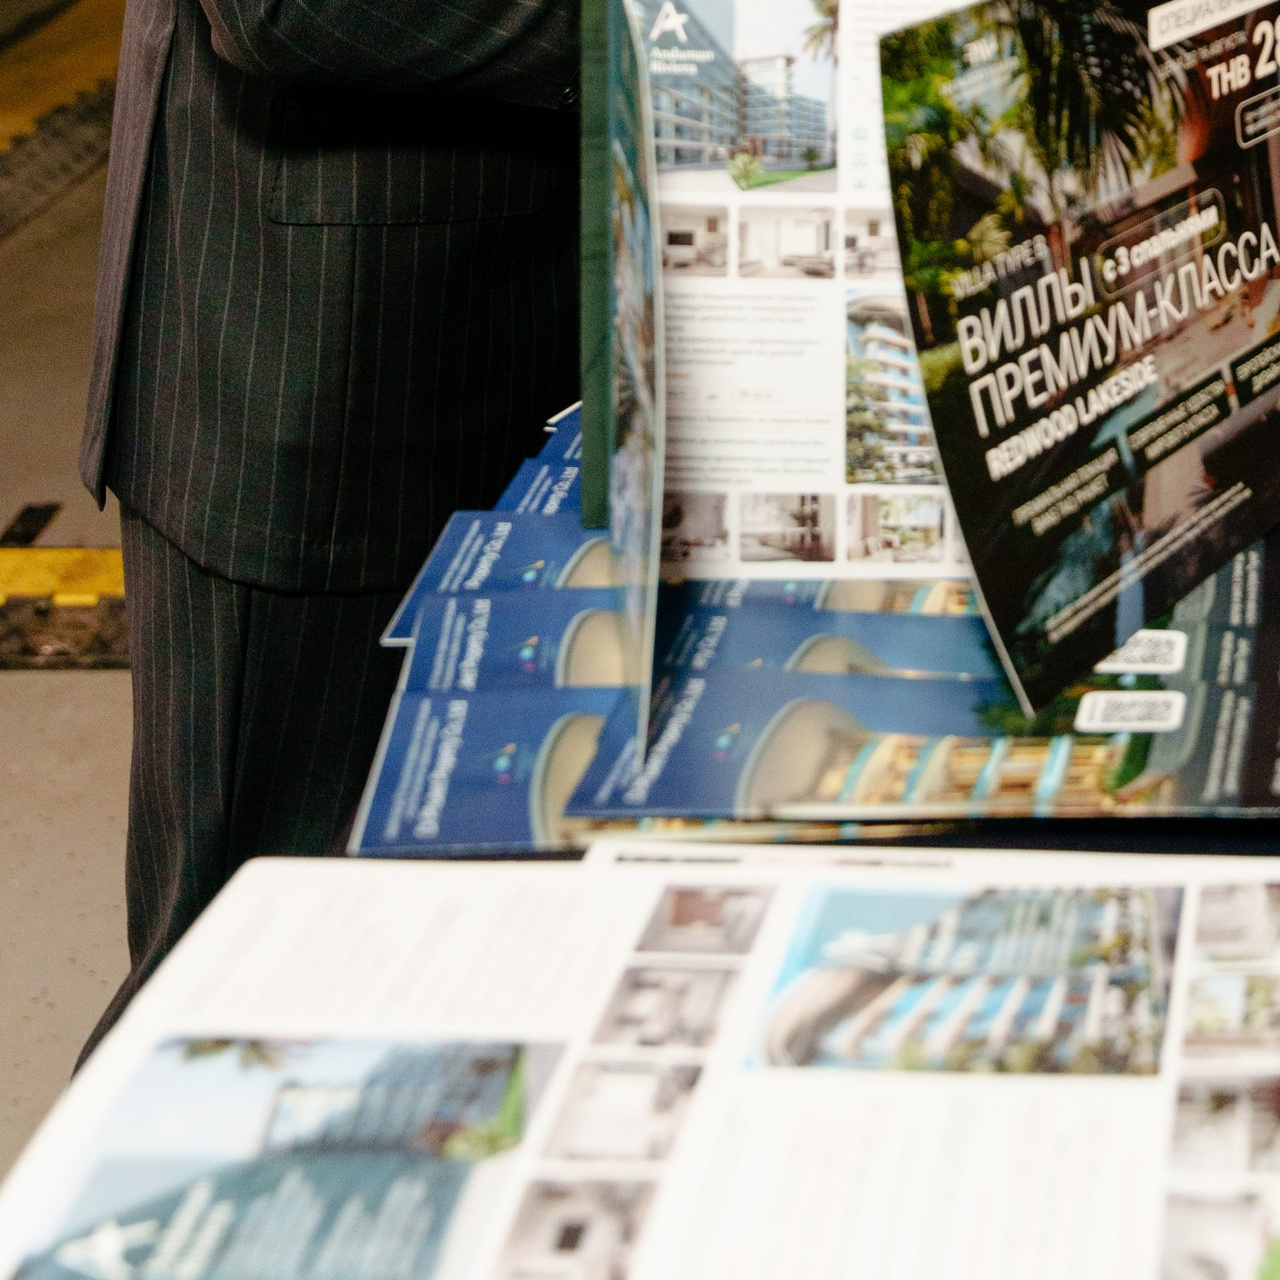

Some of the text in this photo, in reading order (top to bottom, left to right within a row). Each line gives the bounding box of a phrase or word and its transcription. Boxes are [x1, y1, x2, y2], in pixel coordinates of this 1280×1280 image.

[1206, 53, 1251, 101] THB
[957, 256, 1095, 376] ВИЛЛЫ
[1115, 246, 1130, 275] 3
[969, 222, 1280, 438] ПРЕМИУМ-КЛАССА
[985, 403, 1079, 482] REDWOOD
[1076, 354, 1158, 425] LAKESIDE
